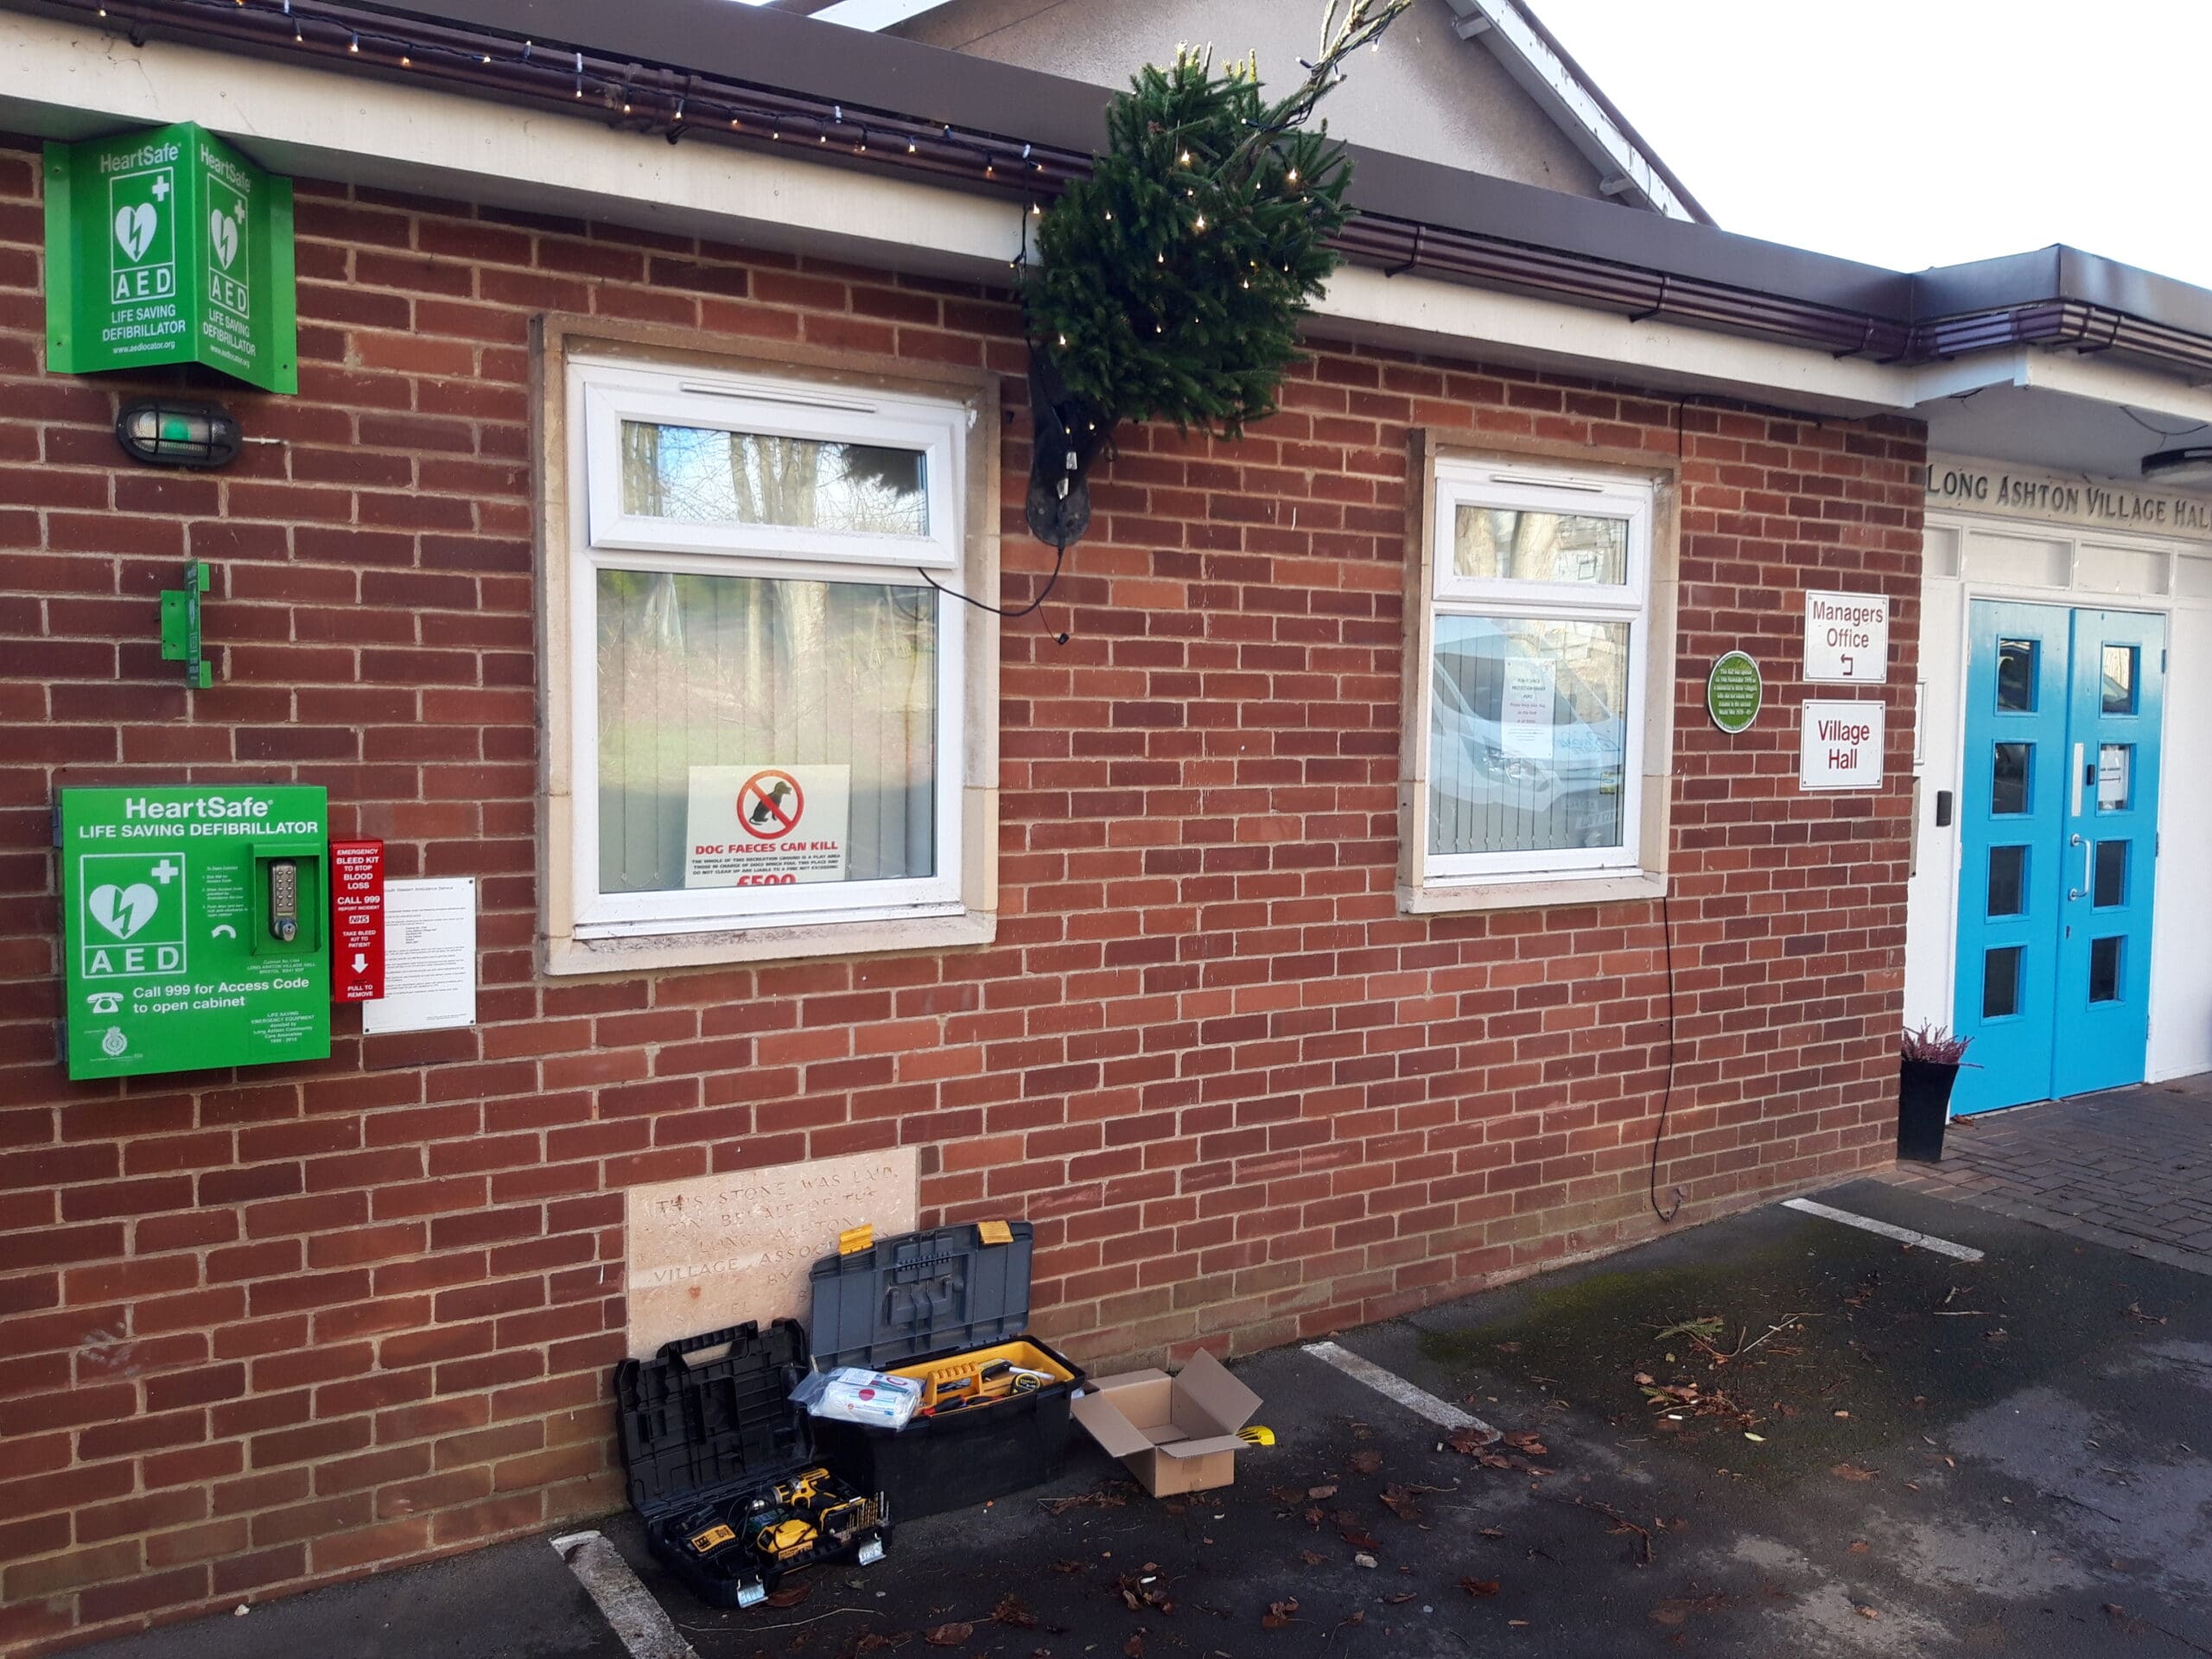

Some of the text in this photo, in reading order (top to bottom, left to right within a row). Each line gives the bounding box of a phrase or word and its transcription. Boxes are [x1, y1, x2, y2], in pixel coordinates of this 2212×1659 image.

[100, 143, 179, 174] HeartSafe
[200, 143, 251, 193] HeartSafe
[116, 268, 172, 299] AED
[211, 275, 247, 312] AED
[111, 304, 176, 324] LIFE SAVING
[208, 308, 250, 338] LIFE SAVING
[102, 320, 186, 341] DEFIBRILLATOR
[203, 322, 256, 357] DEFIBRILLATOR
[1927, 463, 2212, 529] LONG ASHTON VILLAGE HAL
[1813, 601, 1884, 626] Managers
[1827, 627, 1870, 649] Office
[1818, 720, 1870, 746] Village
[1828, 748, 1858, 769] Hall
[126, 797, 269, 818] HeartSafe
[79, 821, 318, 838] LIFE SAVING DEFIBRILLATOR
[696, 841, 838, 855] DOG FAECES CAN KILL
[338, 895, 380, 905] CALL 999
[90, 946, 180, 974] AED
[133, 977, 309, 1000] Call 999 for Access Code
[133, 996, 245, 1015] to open cabinet
[654, 1257, 738, 1282] VILLAGE
